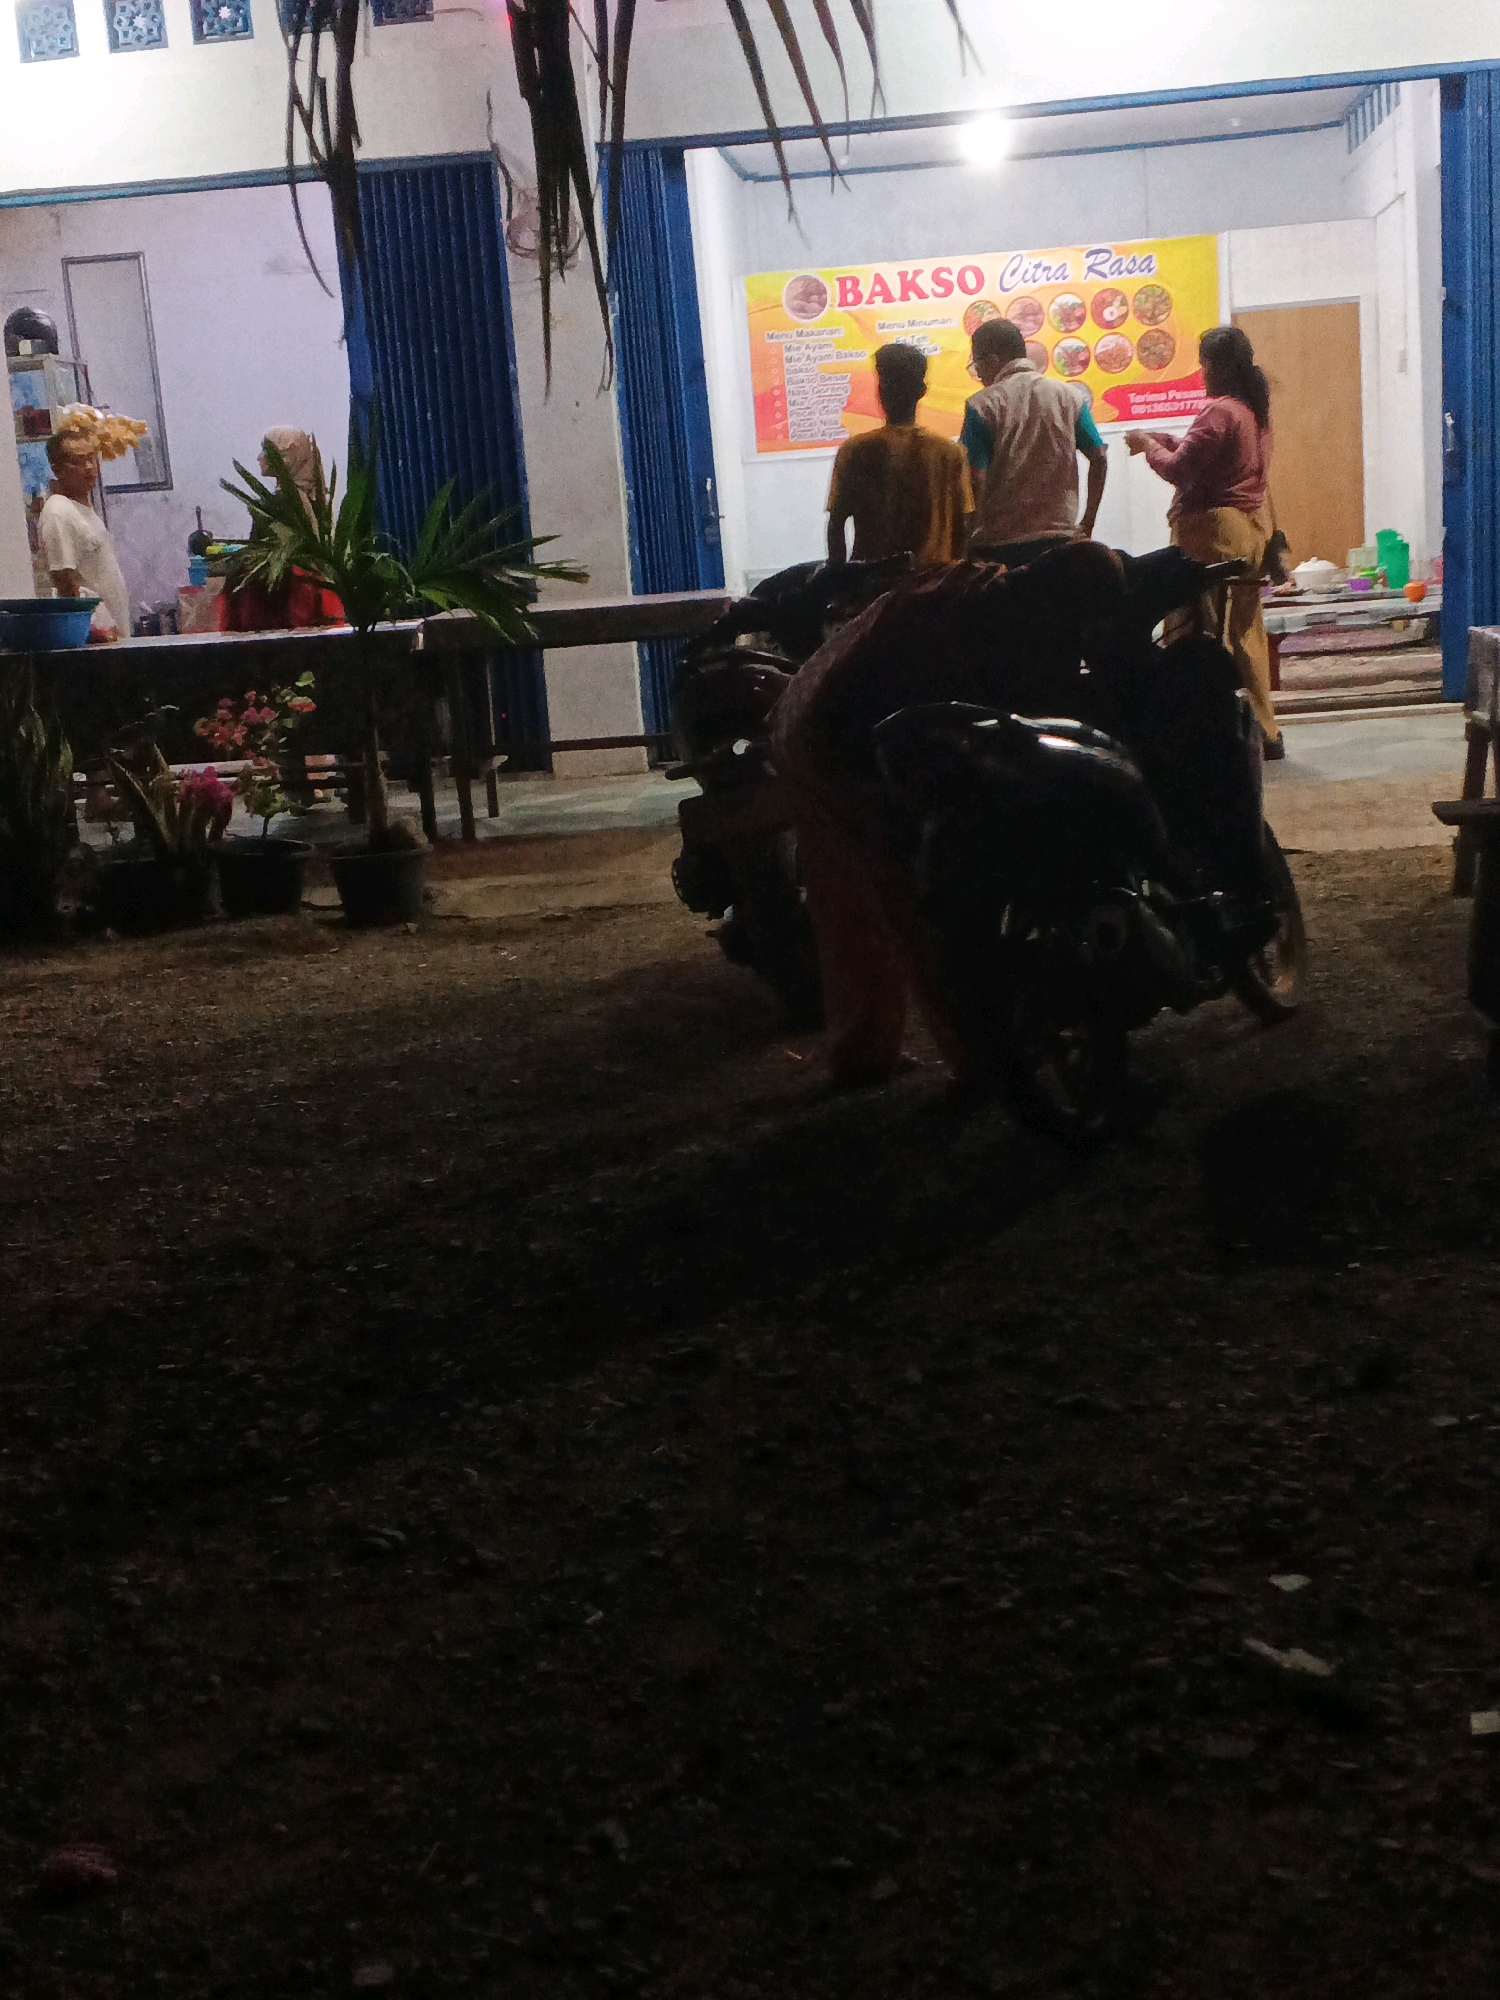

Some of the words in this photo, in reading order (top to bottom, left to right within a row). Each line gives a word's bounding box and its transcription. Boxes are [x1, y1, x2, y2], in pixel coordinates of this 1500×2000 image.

[836, 265, 985, 309] BAKSO
[998, 253, 1071, 293] Citra
[1083, 248, 1156, 280] Rasa
[877, 322, 906, 331] Menu
[766, 332, 793, 341] Menu
[784, 344, 801, 353] Mie
[805, 343, 833, 353] Ayam
[785, 354, 802, 364] Mie
[805, 352, 833, 363] Ayam
[835, 350, 867, 360] Bakso
[819, 374, 849, 384] Besar
[811, 385, 849, 395] Goreng
[808, 397, 845, 406] Goreng
[820, 430, 848, 440] Ayam
